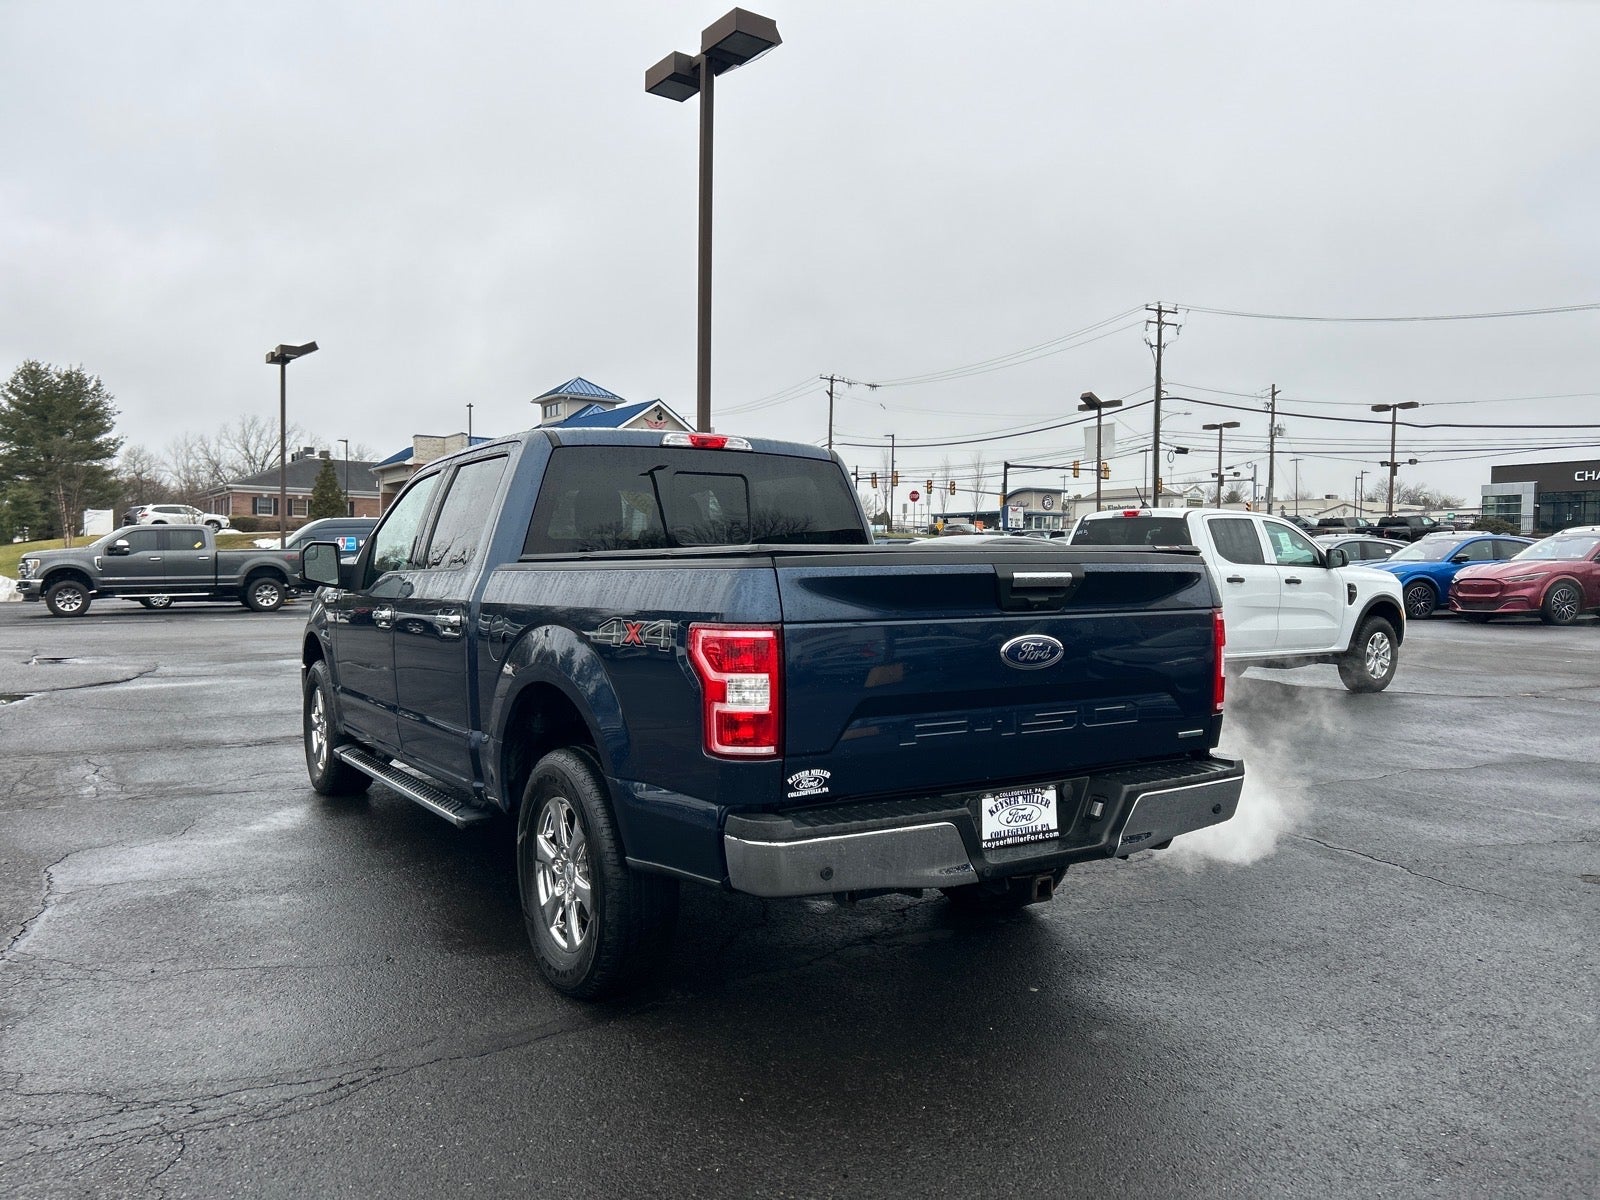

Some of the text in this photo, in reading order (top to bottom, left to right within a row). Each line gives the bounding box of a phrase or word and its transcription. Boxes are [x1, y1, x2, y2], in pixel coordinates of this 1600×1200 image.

[598, 617, 671, 652] 4X4
[1018, 641, 1051, 661] Ford
[787, 769, 831, 784] KEYSER MILLER
[799, 777, 819, 789] Ford
[988, 794, 1051, 817] KEYSER MILLER
[1005, 807, 1034, 825] Ford
[982, 831, 1060, 849] KeyserMillerFord.com
